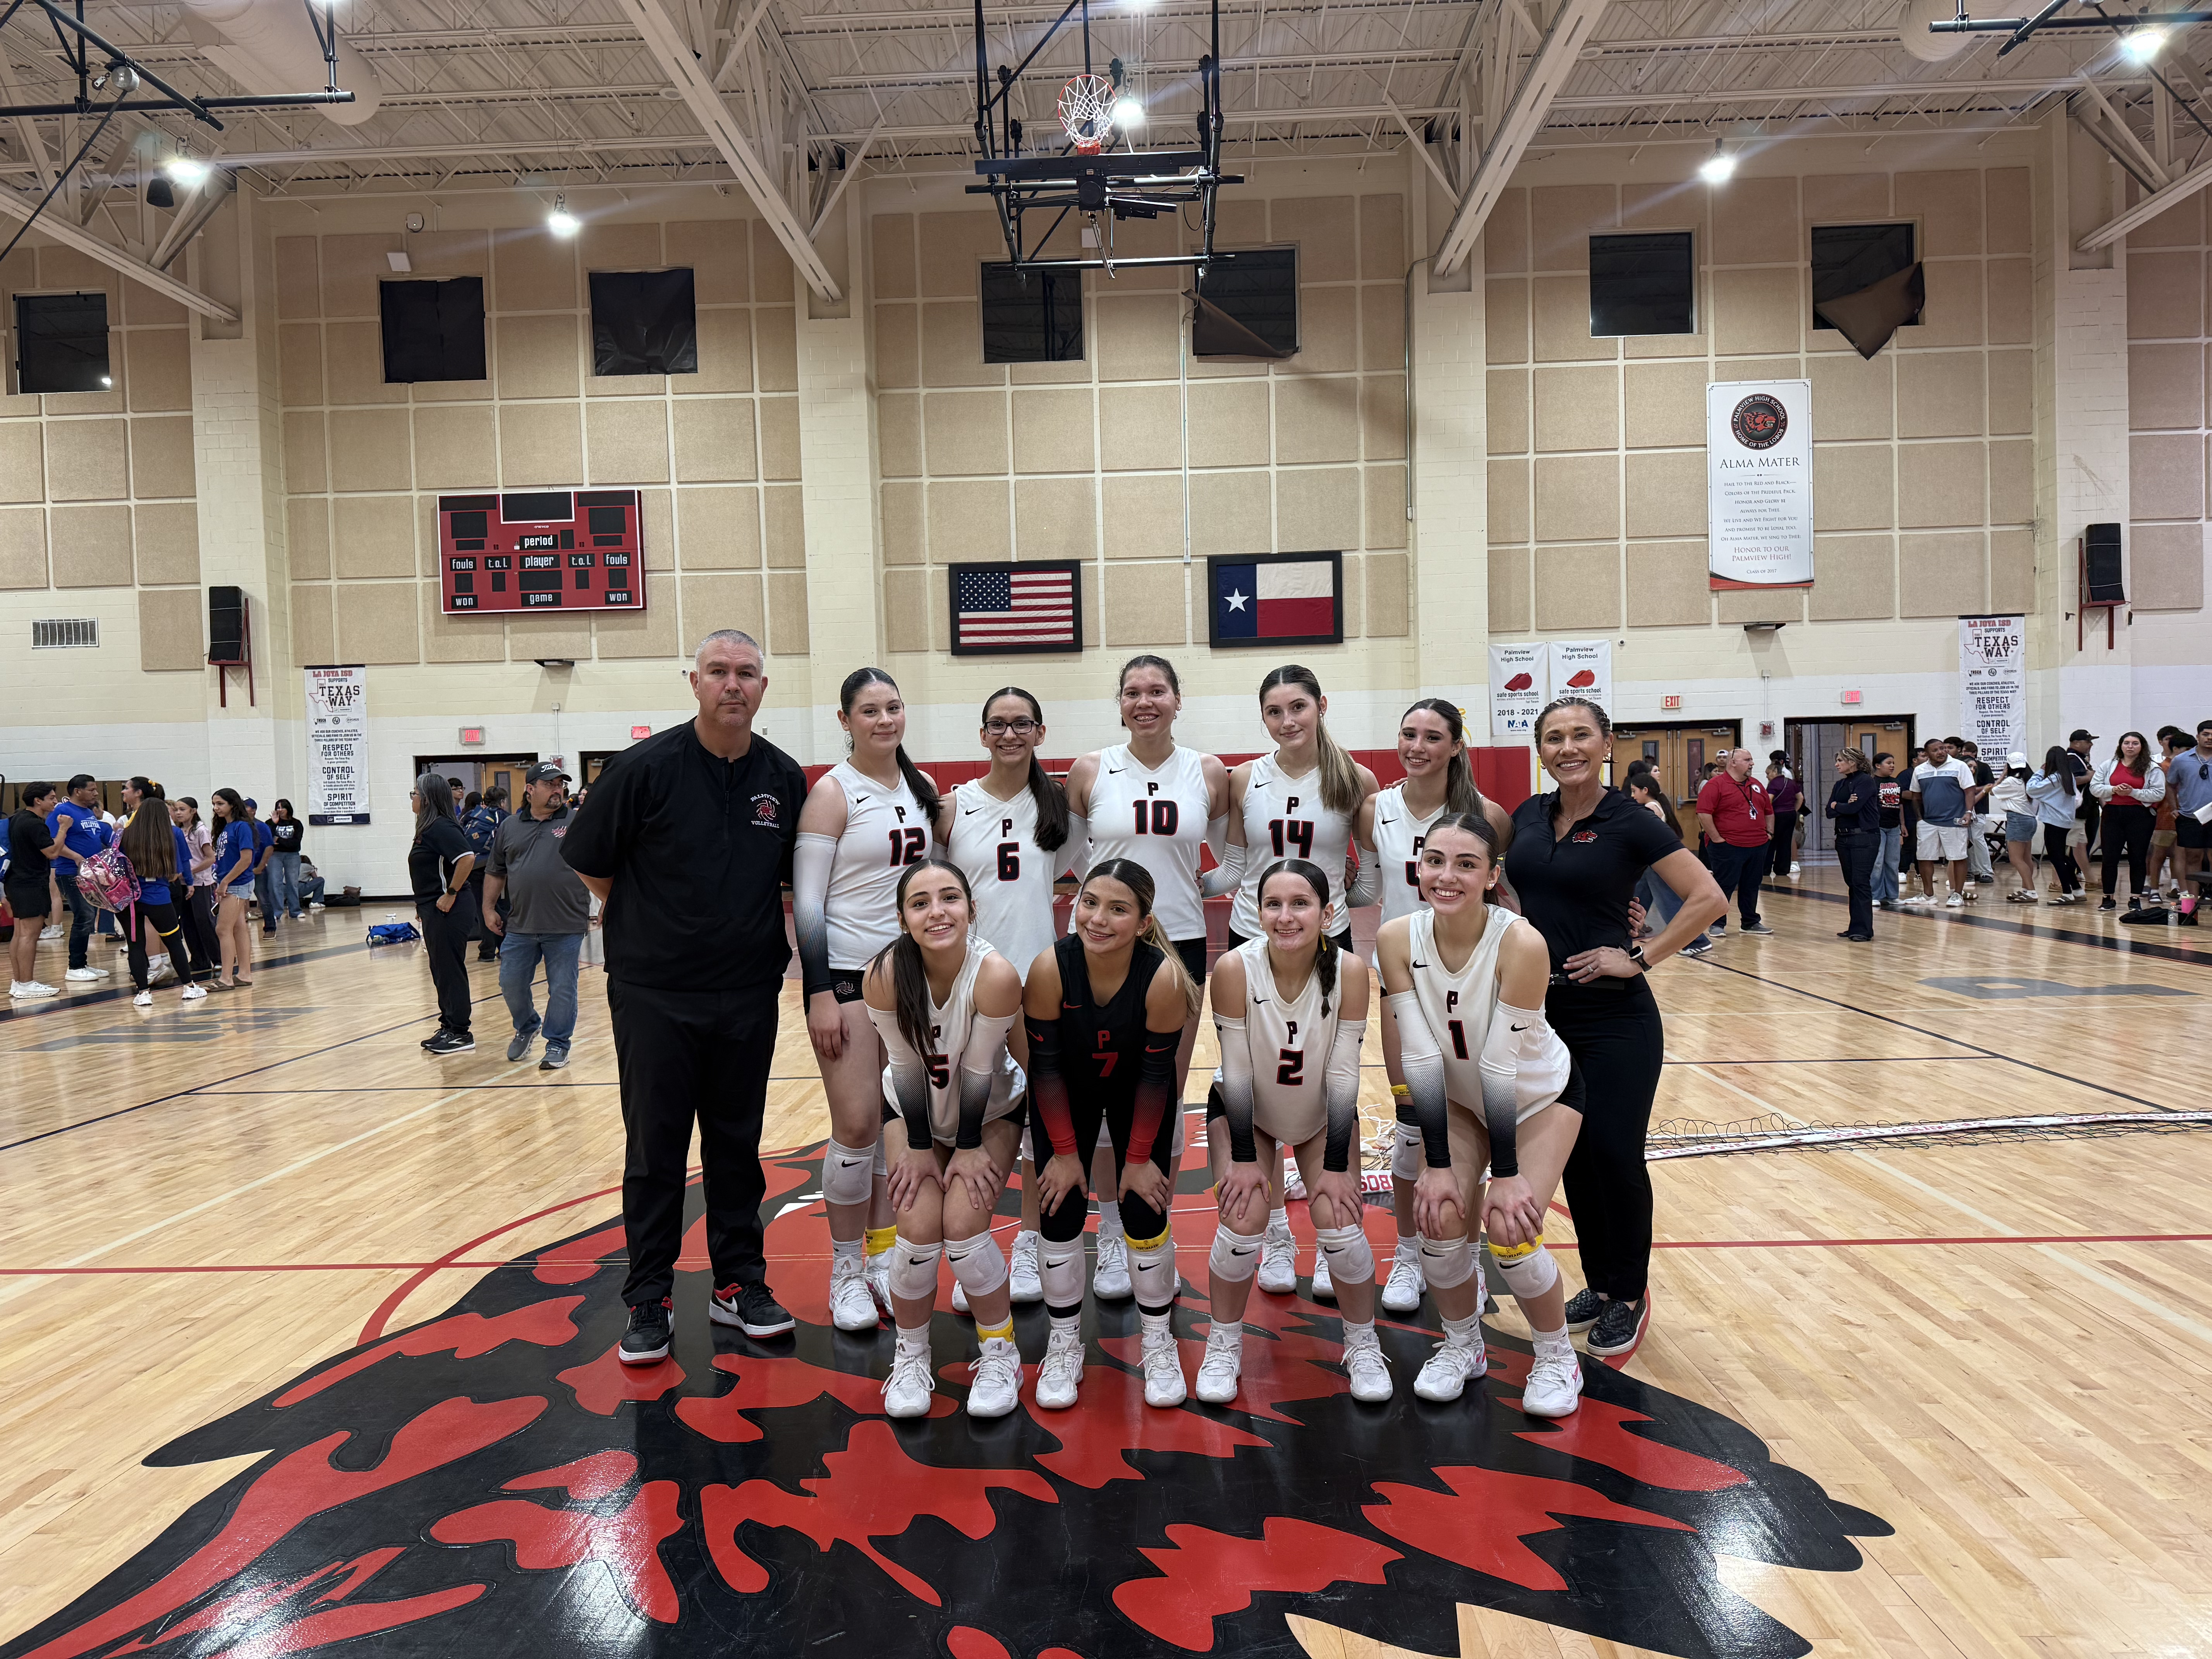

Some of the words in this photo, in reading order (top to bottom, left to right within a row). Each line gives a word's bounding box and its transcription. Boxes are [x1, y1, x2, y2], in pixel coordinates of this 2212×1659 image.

[1771, 399, 1786, 420] SCHOOL
[1735, 430, 1748, 445] HOME
[1770, 428, 1784, 444] LOBOS
[1720, 459, 1754, 469] ALMA
[1759, 457, 1800, 467] MATER
[525, 535, 553, 548] period
[453, 559, 473, 569] fouls
[525, 556, 554, 567] player
[606, 555, 627, 565] fouls
[530, 593, 553, 604] game
[610, 593, 627, 601] won
[1975, 635, 2018, 647] TEXAS
[1984, 647, 2010, 657] WAY
[319, 685, 359, 696] TEXAS
[328, 696, 352, 706] WAY
[1666, 696, 1680, 707] EXIT
[1147, 782, 1159, 796] P
[1879, 787, 1901, 795] STRONG
[750, 793, 780, 805] PALMVIEW
[1286, 797, 1299, 814] P
[895, 806, 906, 823] P
[1133, 800, 1178, 836] 10
[1002, 819, 1012, 837] P
[889, 827, 926, 867] 12
[1268, 819, 1314, 859] 14
[1413, 836, 1424, 855] P
[997, 842, 1020, 881] 6
[1447, 990, 1458, 1014] P
[1098, 1030, 1110, 1049] P
[1286, 1021, 1297, 1044] P
[1448, 1020, 1469, 1060] 1
[927, 1054, 950, 1089] 5
[1092, 1052, 1118, 1077] 7
[1276, 1048, 1304, 1086] 2
